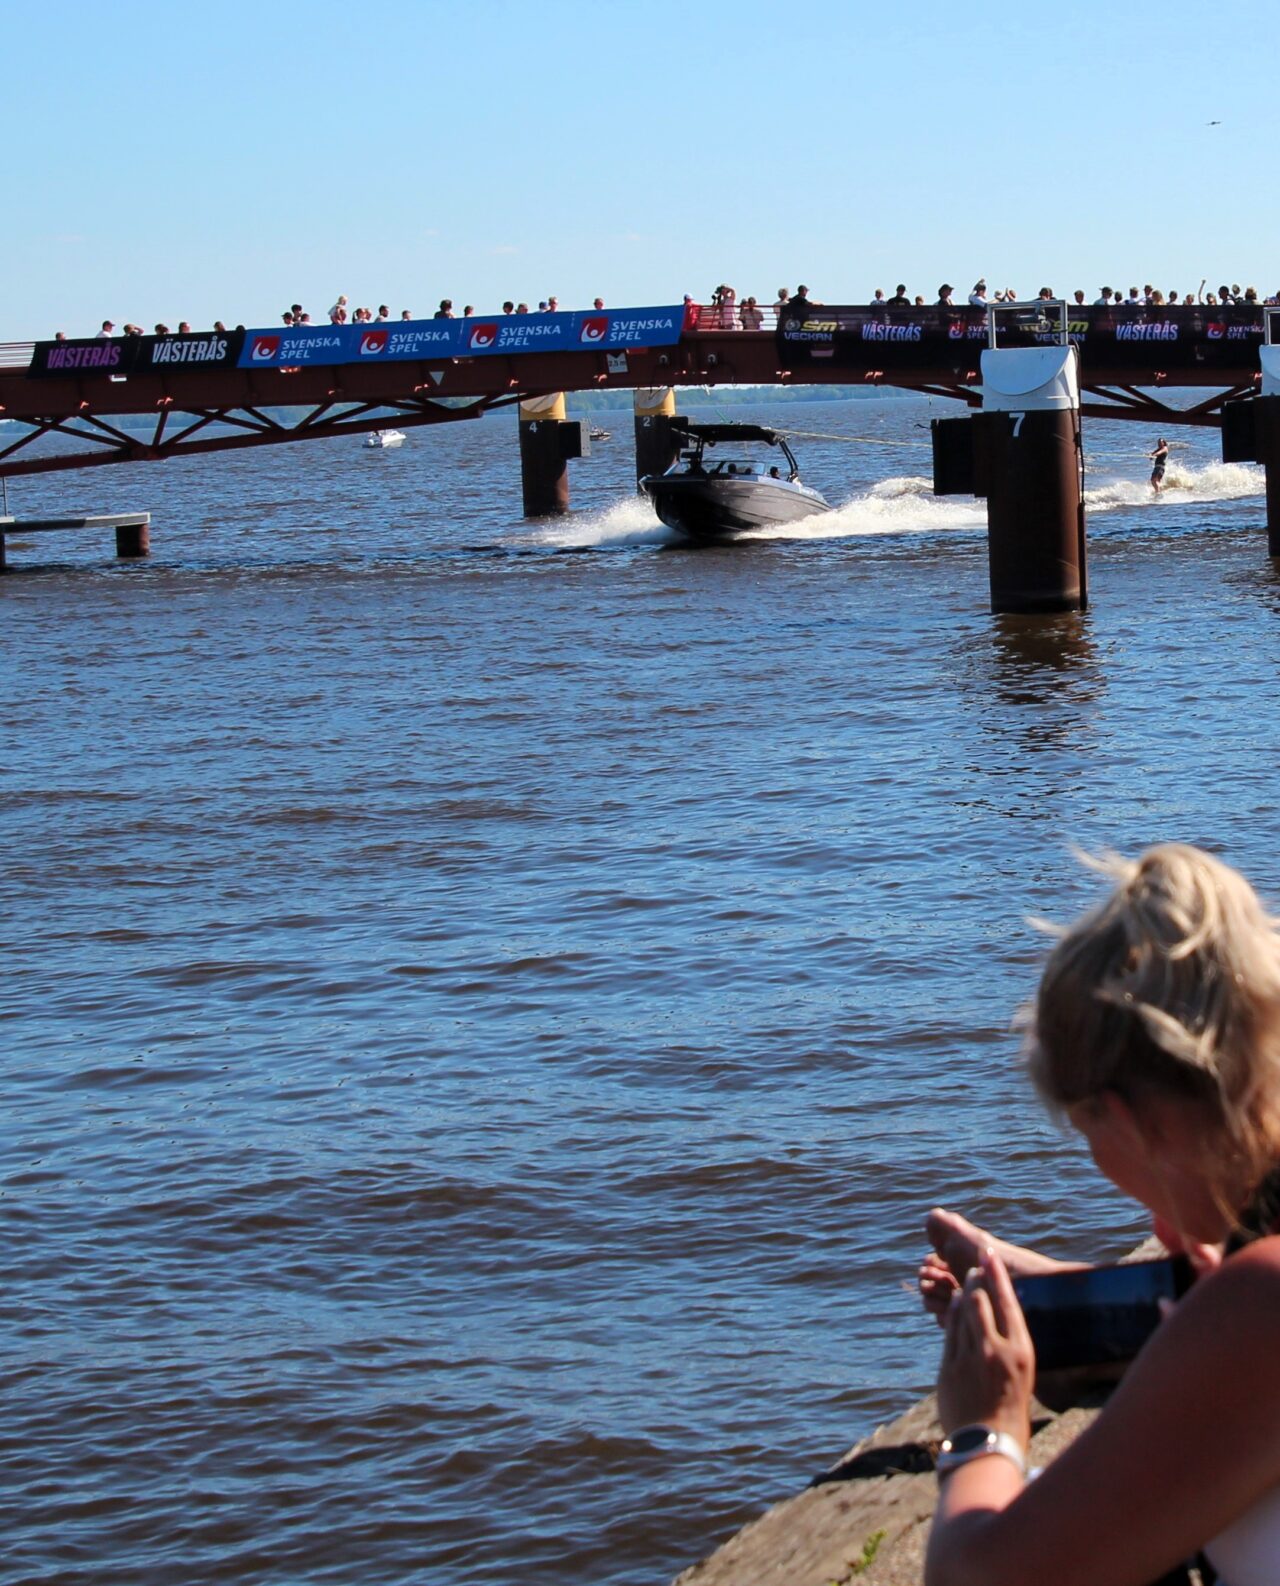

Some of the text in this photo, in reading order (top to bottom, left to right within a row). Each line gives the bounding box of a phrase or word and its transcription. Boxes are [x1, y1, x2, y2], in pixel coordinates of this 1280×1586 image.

[500, 325, 561, 337] SVENSKA
[612, 319, 673, 331] SVENSKA
[862, 321, 922, 341] VÄSTERÅS
[1115, 320, 1178, 341] VÄSTERÅS
[390, 332, 450, 344] SVENSKA
[498, 336, 530, 347] SPEL
[610, 330, 641, 342] SPEL
[784, 332, 832, 341] VECKAN
[1035, 333, 1086, 342] VECAN
[152, 336, 228, 363] VÄSTERÅS
[283, 337, 341, 350] SVENSKA
[388, 342, 419, 354] SPEL
[47, 343, 122, 369] VÄSTERÅS
[280, 348, 311, 360] SPEL
[529, 422, 537, 432] 4
[643, 416, 651, 427] 2
[1009, 412, 1025, 437] 7
